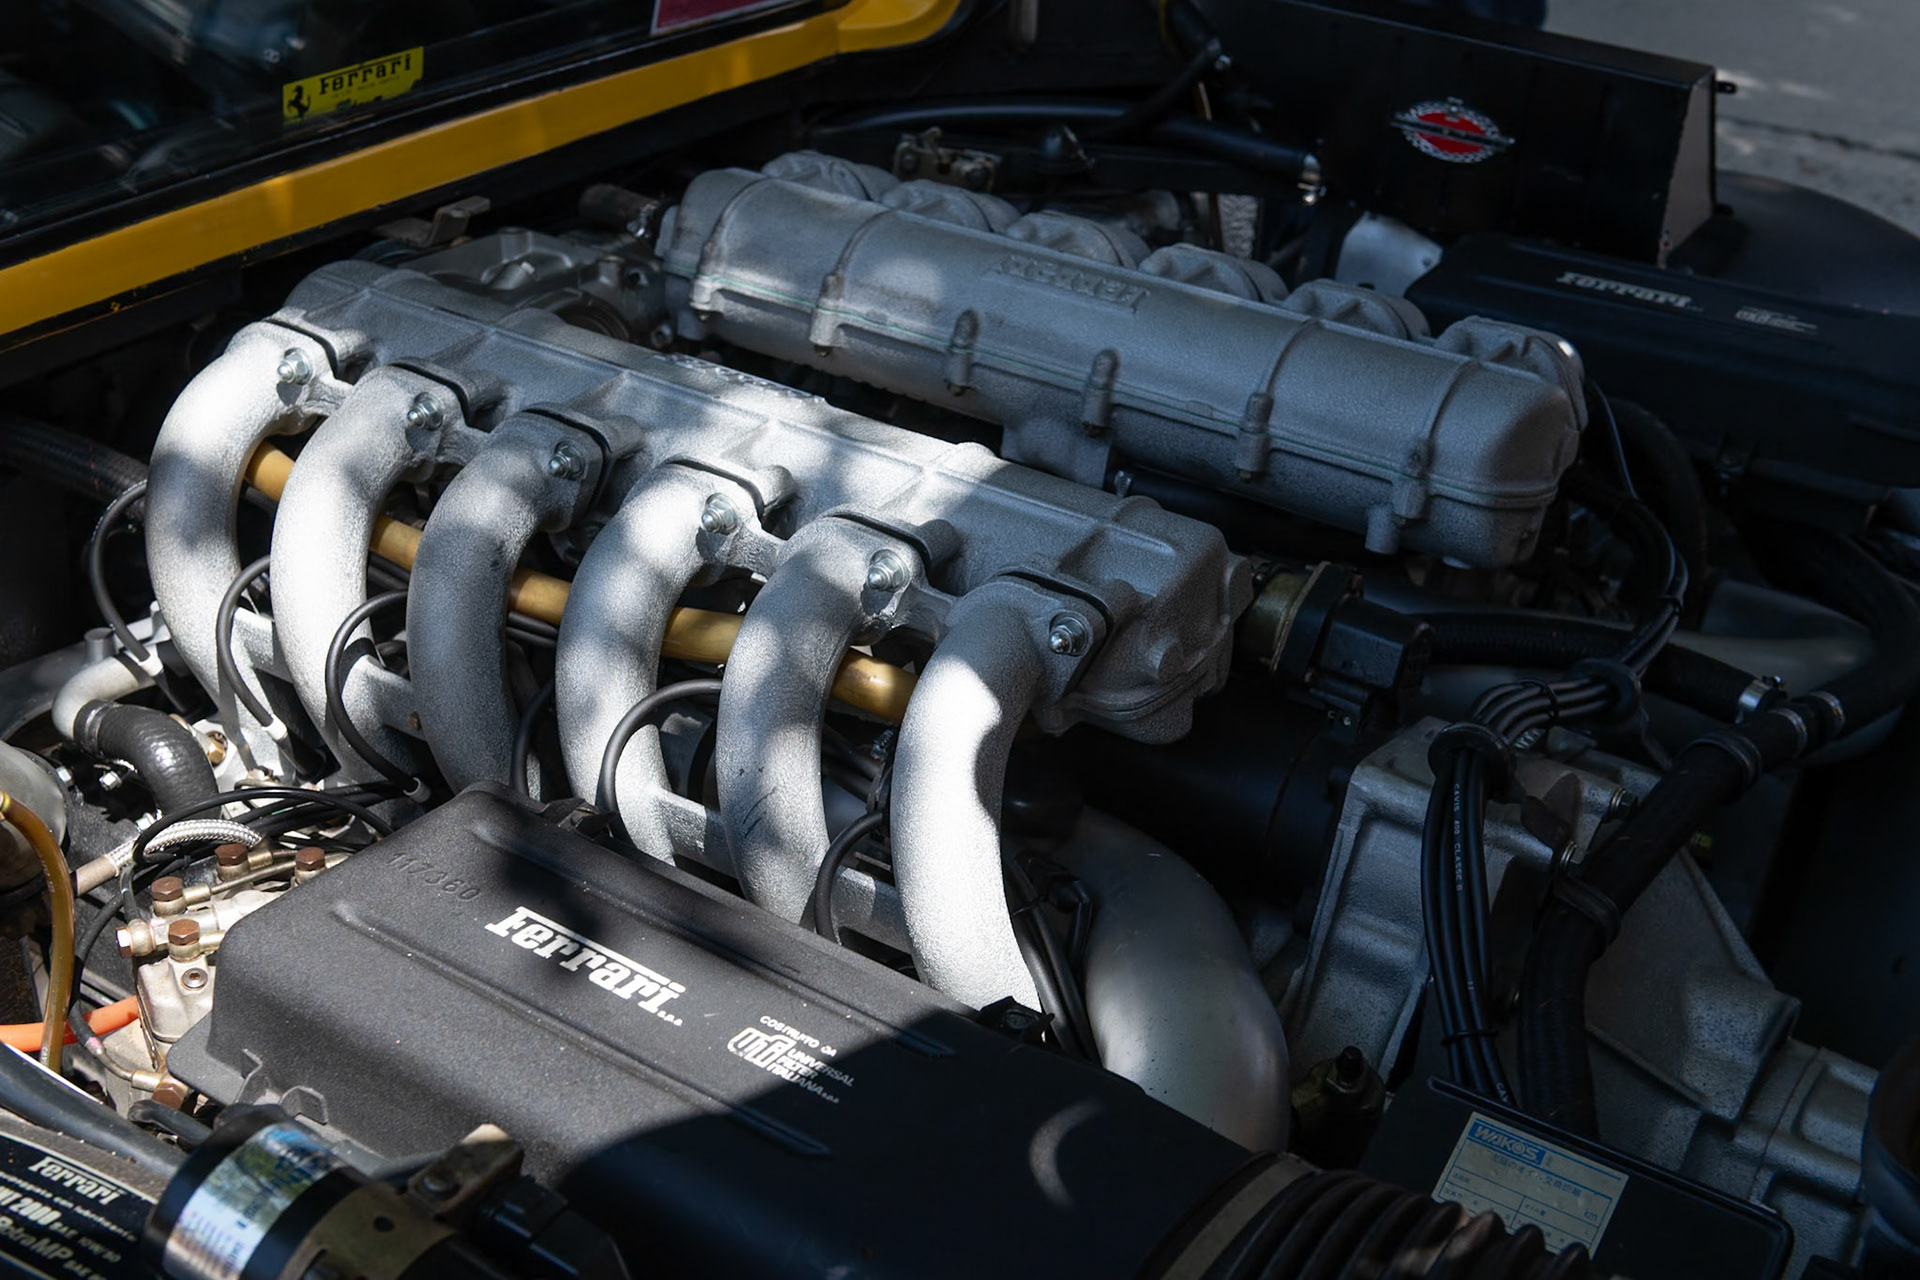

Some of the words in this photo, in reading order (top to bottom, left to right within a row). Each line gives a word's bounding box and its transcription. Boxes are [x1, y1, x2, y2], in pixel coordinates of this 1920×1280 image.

[319, 53, 411, 95] Ferrari
[1555, 271, 1693, 308] Ferrari
[485, 906, 686, 1013] Ferrari
[760, 1015, 820, 1048] COSTRUITO
[766, 1061, 824, 1095] ITALIANA
[776, 1055, 819, 1080] FILTER
[787, 1048, 855, 1087] UNIVERSAL
[28, 1156, 127, 1205] Ferrari
[8, 1196, 62, 1227] 2000
[1583, 1207, 1599, 1222] km
